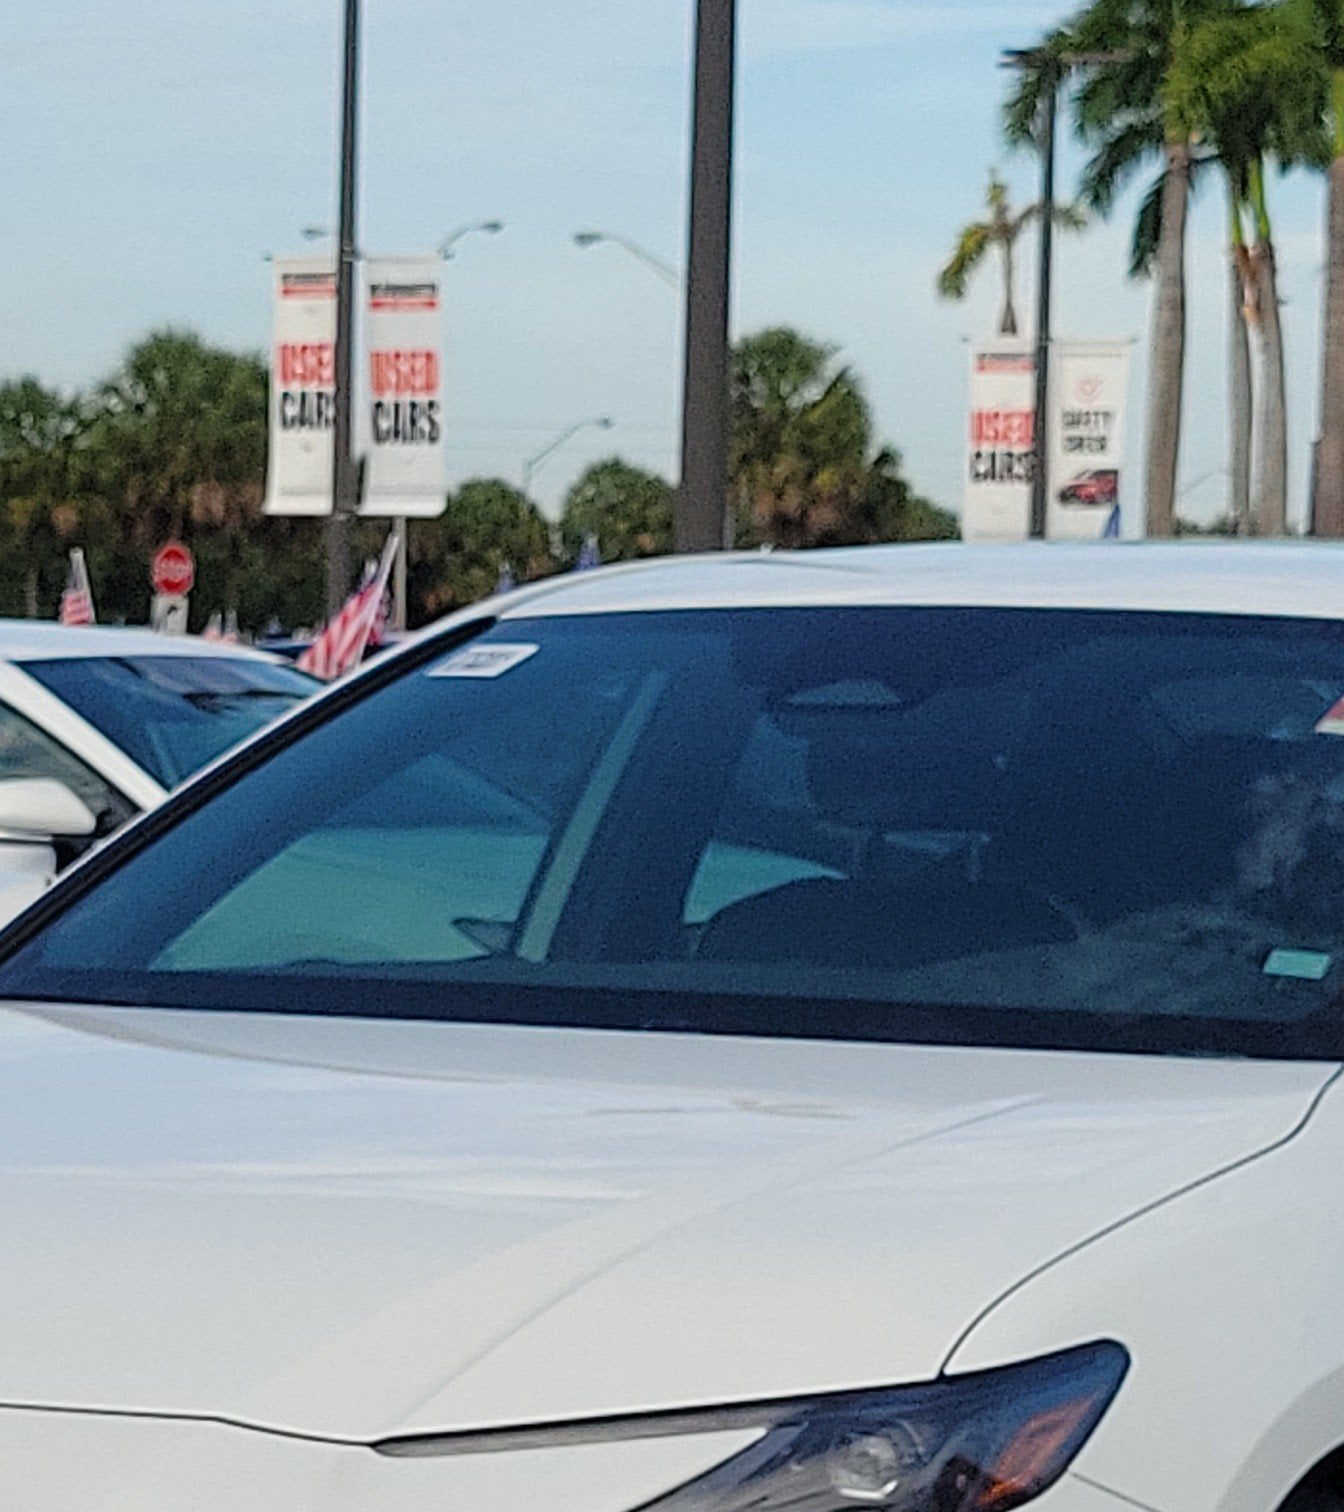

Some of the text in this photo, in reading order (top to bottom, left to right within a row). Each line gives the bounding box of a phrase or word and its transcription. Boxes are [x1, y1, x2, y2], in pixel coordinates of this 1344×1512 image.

[281, 344, 332, 384] USE
[370, 352, 438, 395] USED
[281, 391, 334, 431] CAR
[372, 400, 440, 444] CARS
[972, 411, 1033, 445] USED
[970, 450, 1038, 483] CARS
